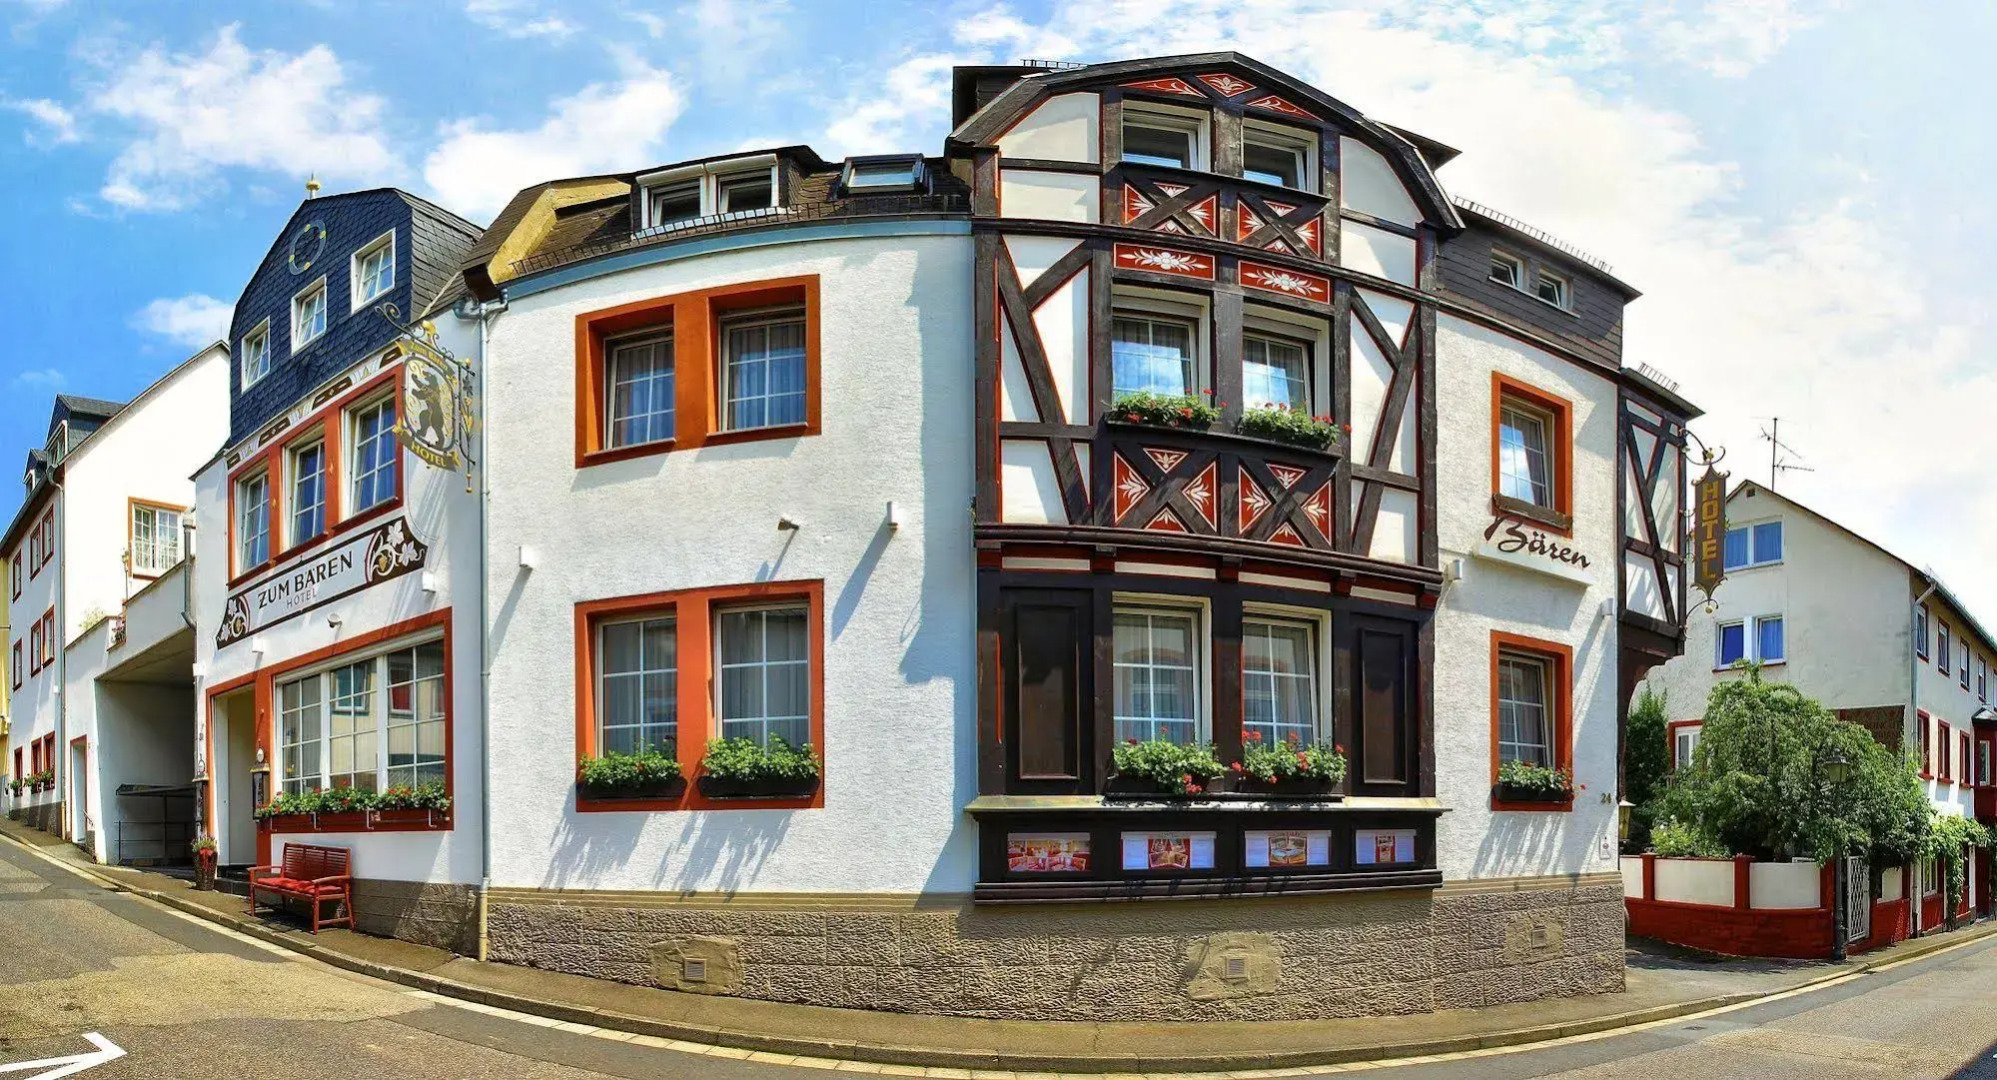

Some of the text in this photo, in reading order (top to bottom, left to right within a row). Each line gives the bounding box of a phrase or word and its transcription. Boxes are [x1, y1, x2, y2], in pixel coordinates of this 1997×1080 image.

[411, 440, 447, 467] HOTEL
[1484, 514, 1591, 568] Bären
[1702, 480, 1719, 580] HOTEL
[257, 550, 353, 610] ZUM BÄREN
[285, 587, 317, 610] HOTEL
